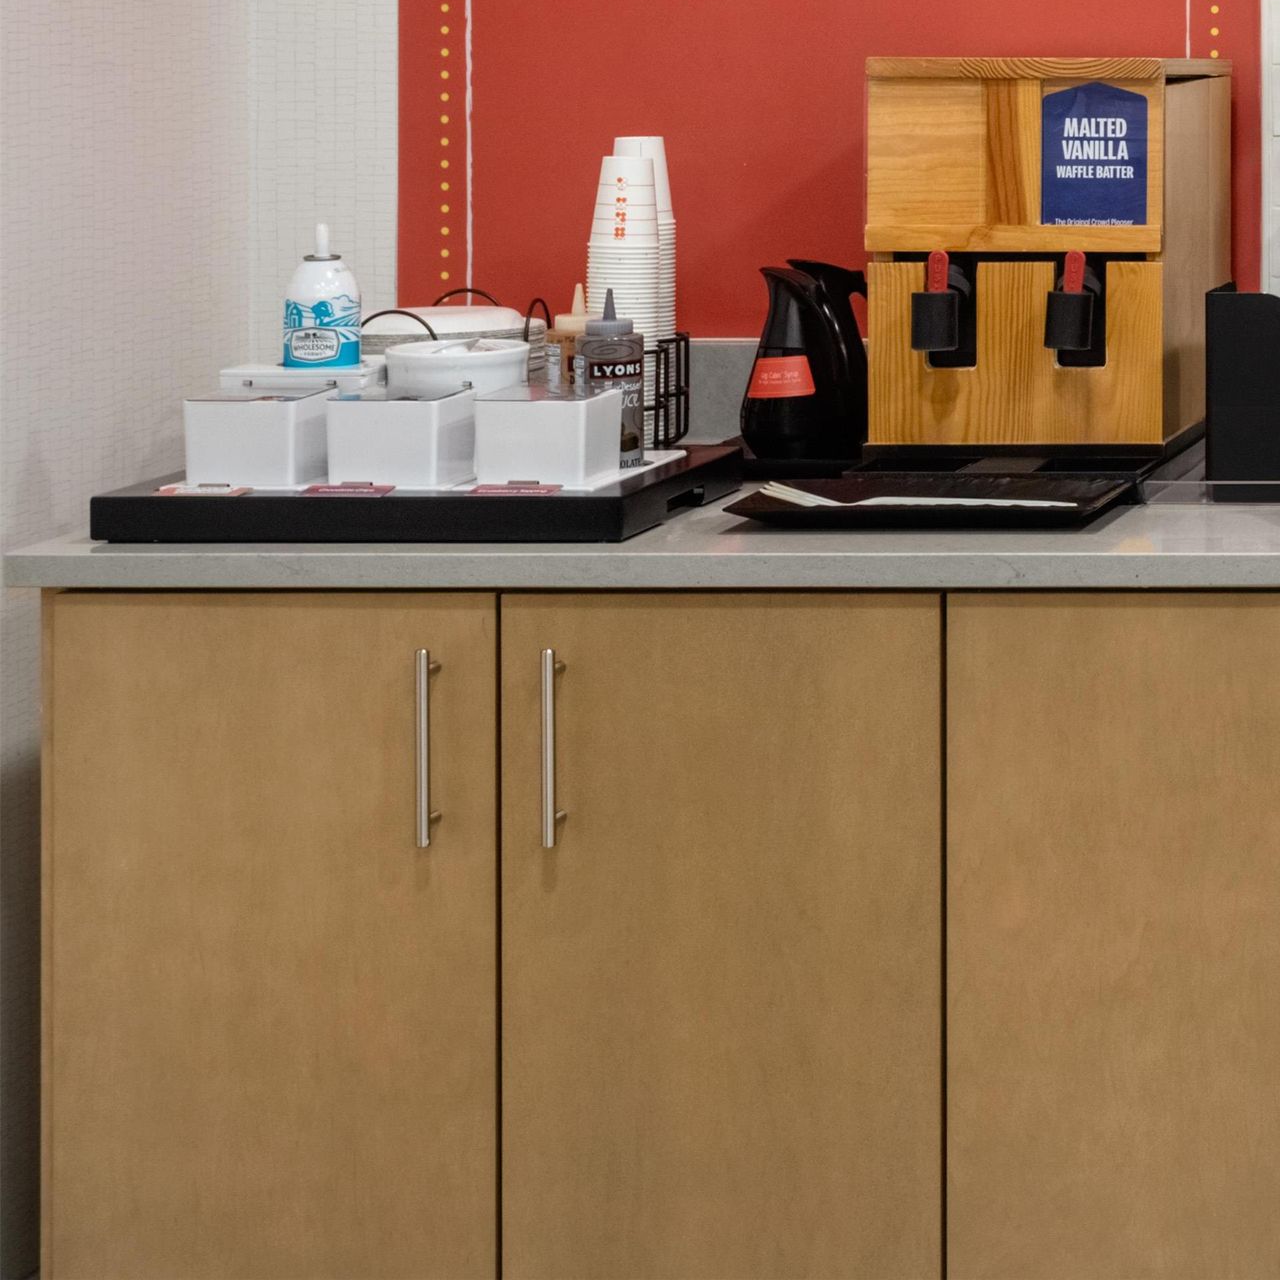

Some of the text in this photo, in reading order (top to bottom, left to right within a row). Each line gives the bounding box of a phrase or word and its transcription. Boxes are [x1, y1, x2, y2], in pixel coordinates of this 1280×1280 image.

[1063, 118, 1127, 137] MALTED
[1062, 140, 1129, 160] VANILLA
[1056, 166, 1134, 179] WAFFLE BATTER
[593, 363, 641, 376] LYONS
